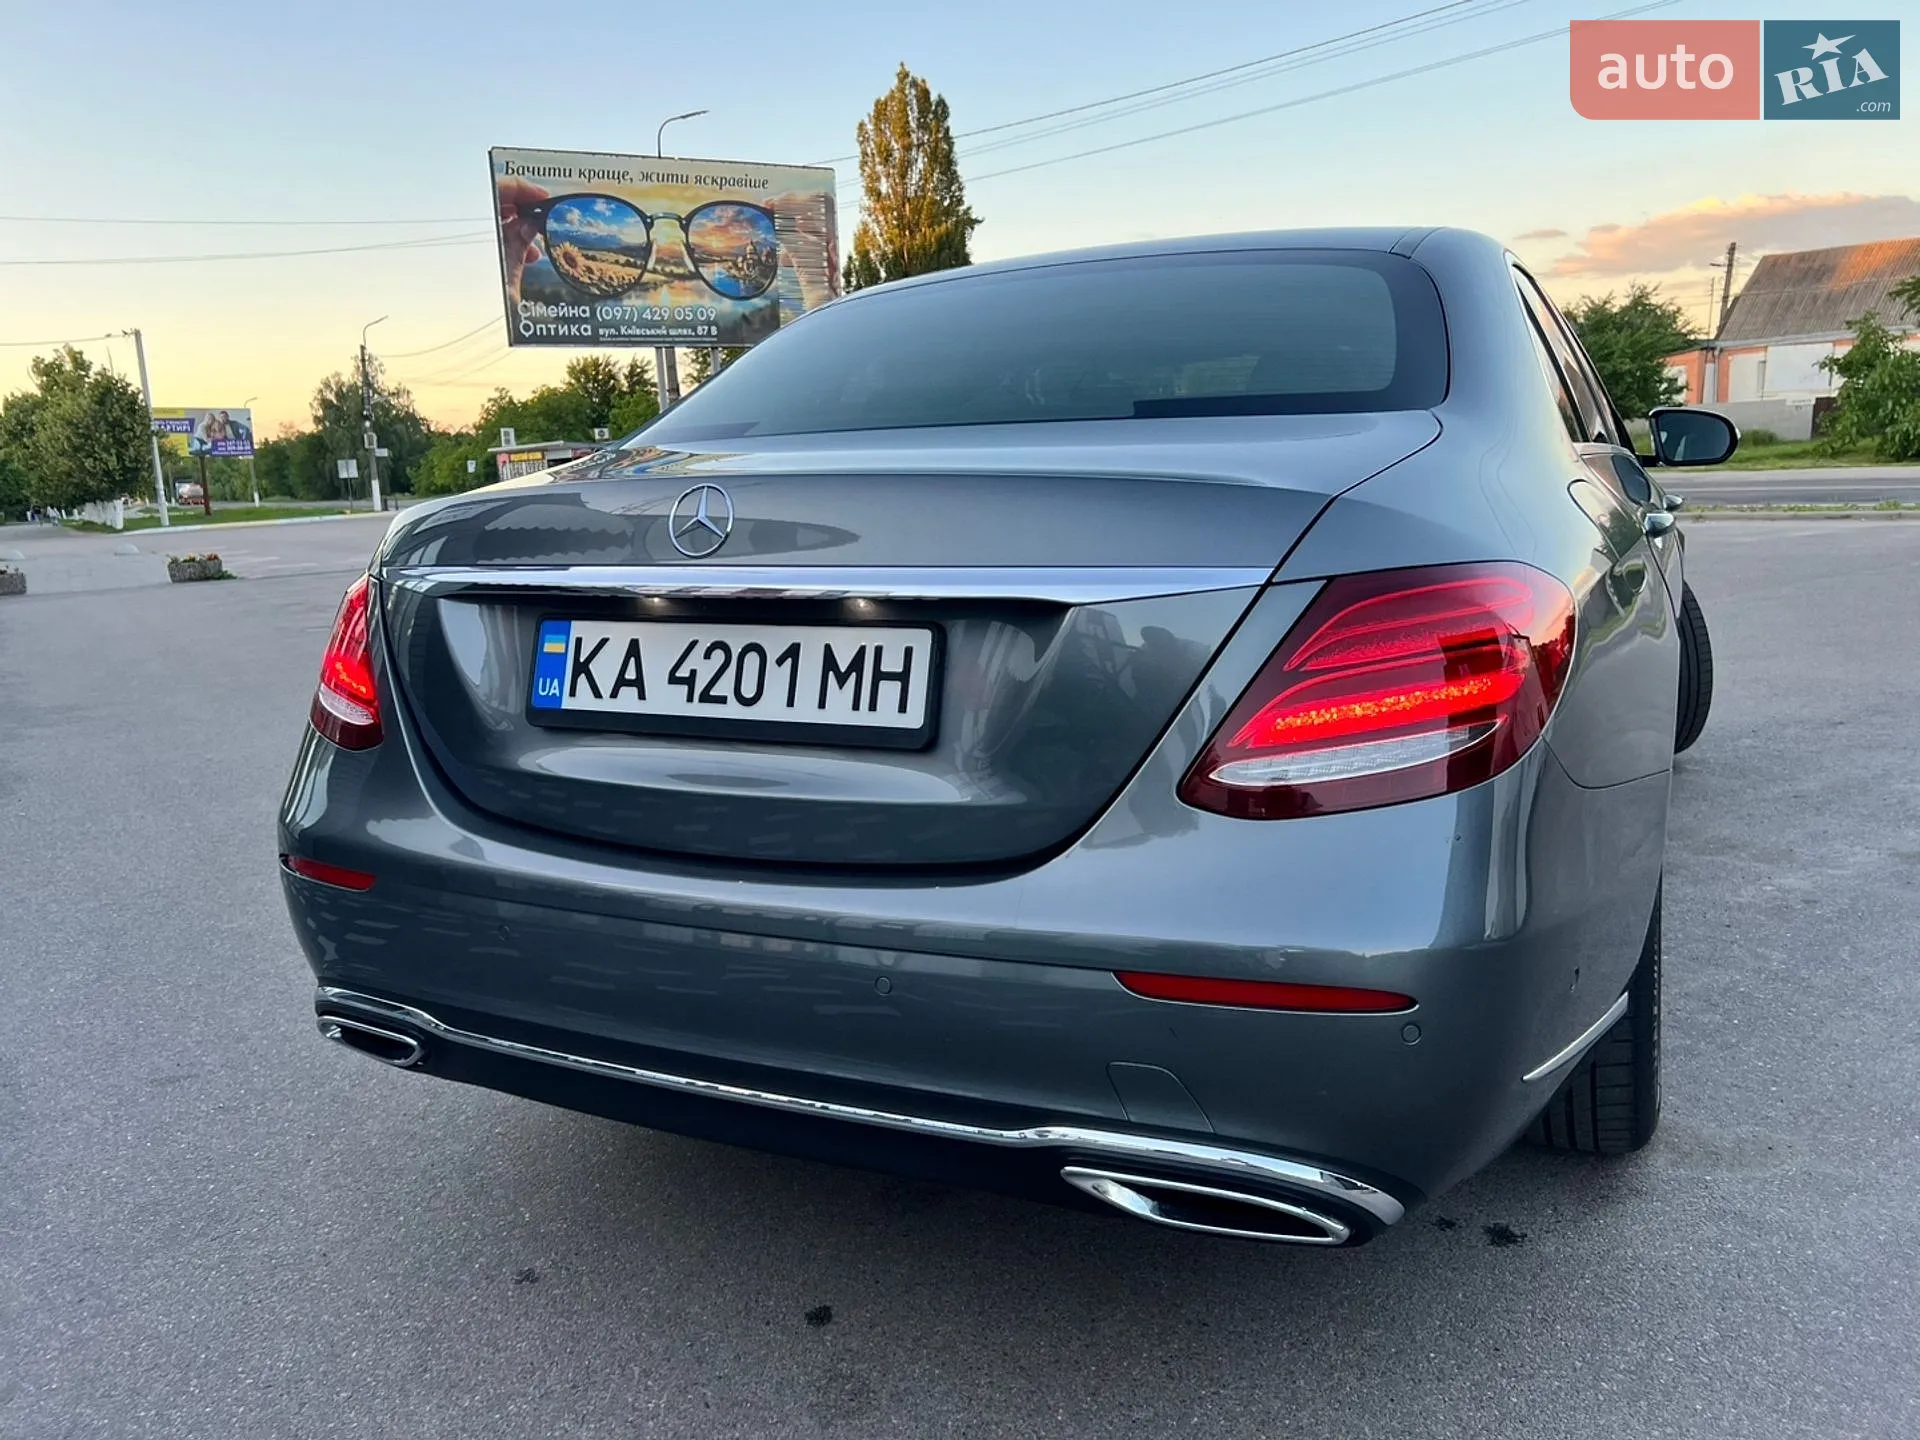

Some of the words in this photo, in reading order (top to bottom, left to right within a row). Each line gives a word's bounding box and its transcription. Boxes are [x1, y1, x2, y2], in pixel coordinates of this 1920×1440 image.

[504, 160, 573, 178] Бачити
[577, 167, 634, 185] краще,
[638, 170, 689, 184] жити
[694, 172, 769, 190] яскравіше
[517, 300, 590, 319] Сімейна
[596, 306, 638, 322] (097)
[642, 306, 669, 320] 429
[674, 307, 693, 321] 05
[697, 308, 716, 321] 09
[519, 319, 592, 337] Оптика
[568, 636, 647, 700] KA
[667, 638, 801, 708] 4201
[817, 642, 914, 714] MH
[538, 677, 560, 697] UA
